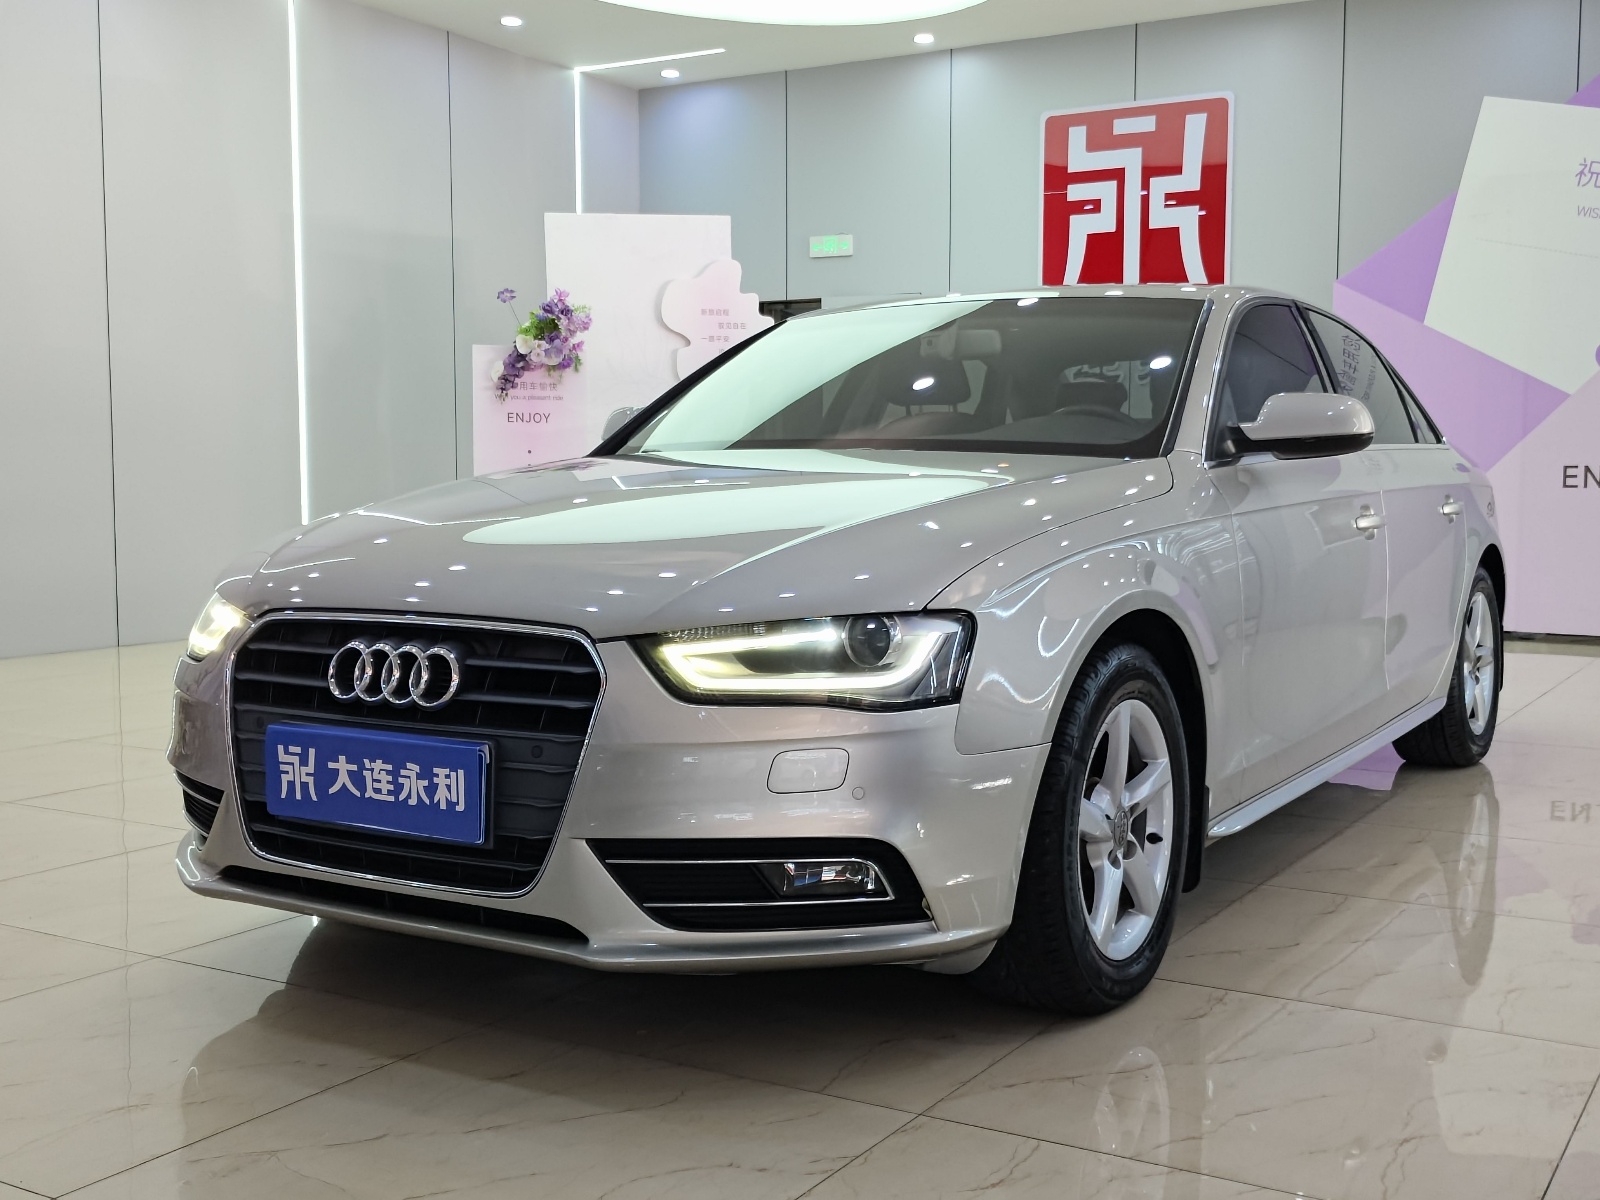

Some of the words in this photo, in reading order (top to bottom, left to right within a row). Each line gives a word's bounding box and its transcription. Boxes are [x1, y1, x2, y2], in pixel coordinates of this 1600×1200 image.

[1577, 204, 1600, 219] WIS
[507, 412, 551, 424] ENJOY
[327, 755, 465, 812] 大连永利
